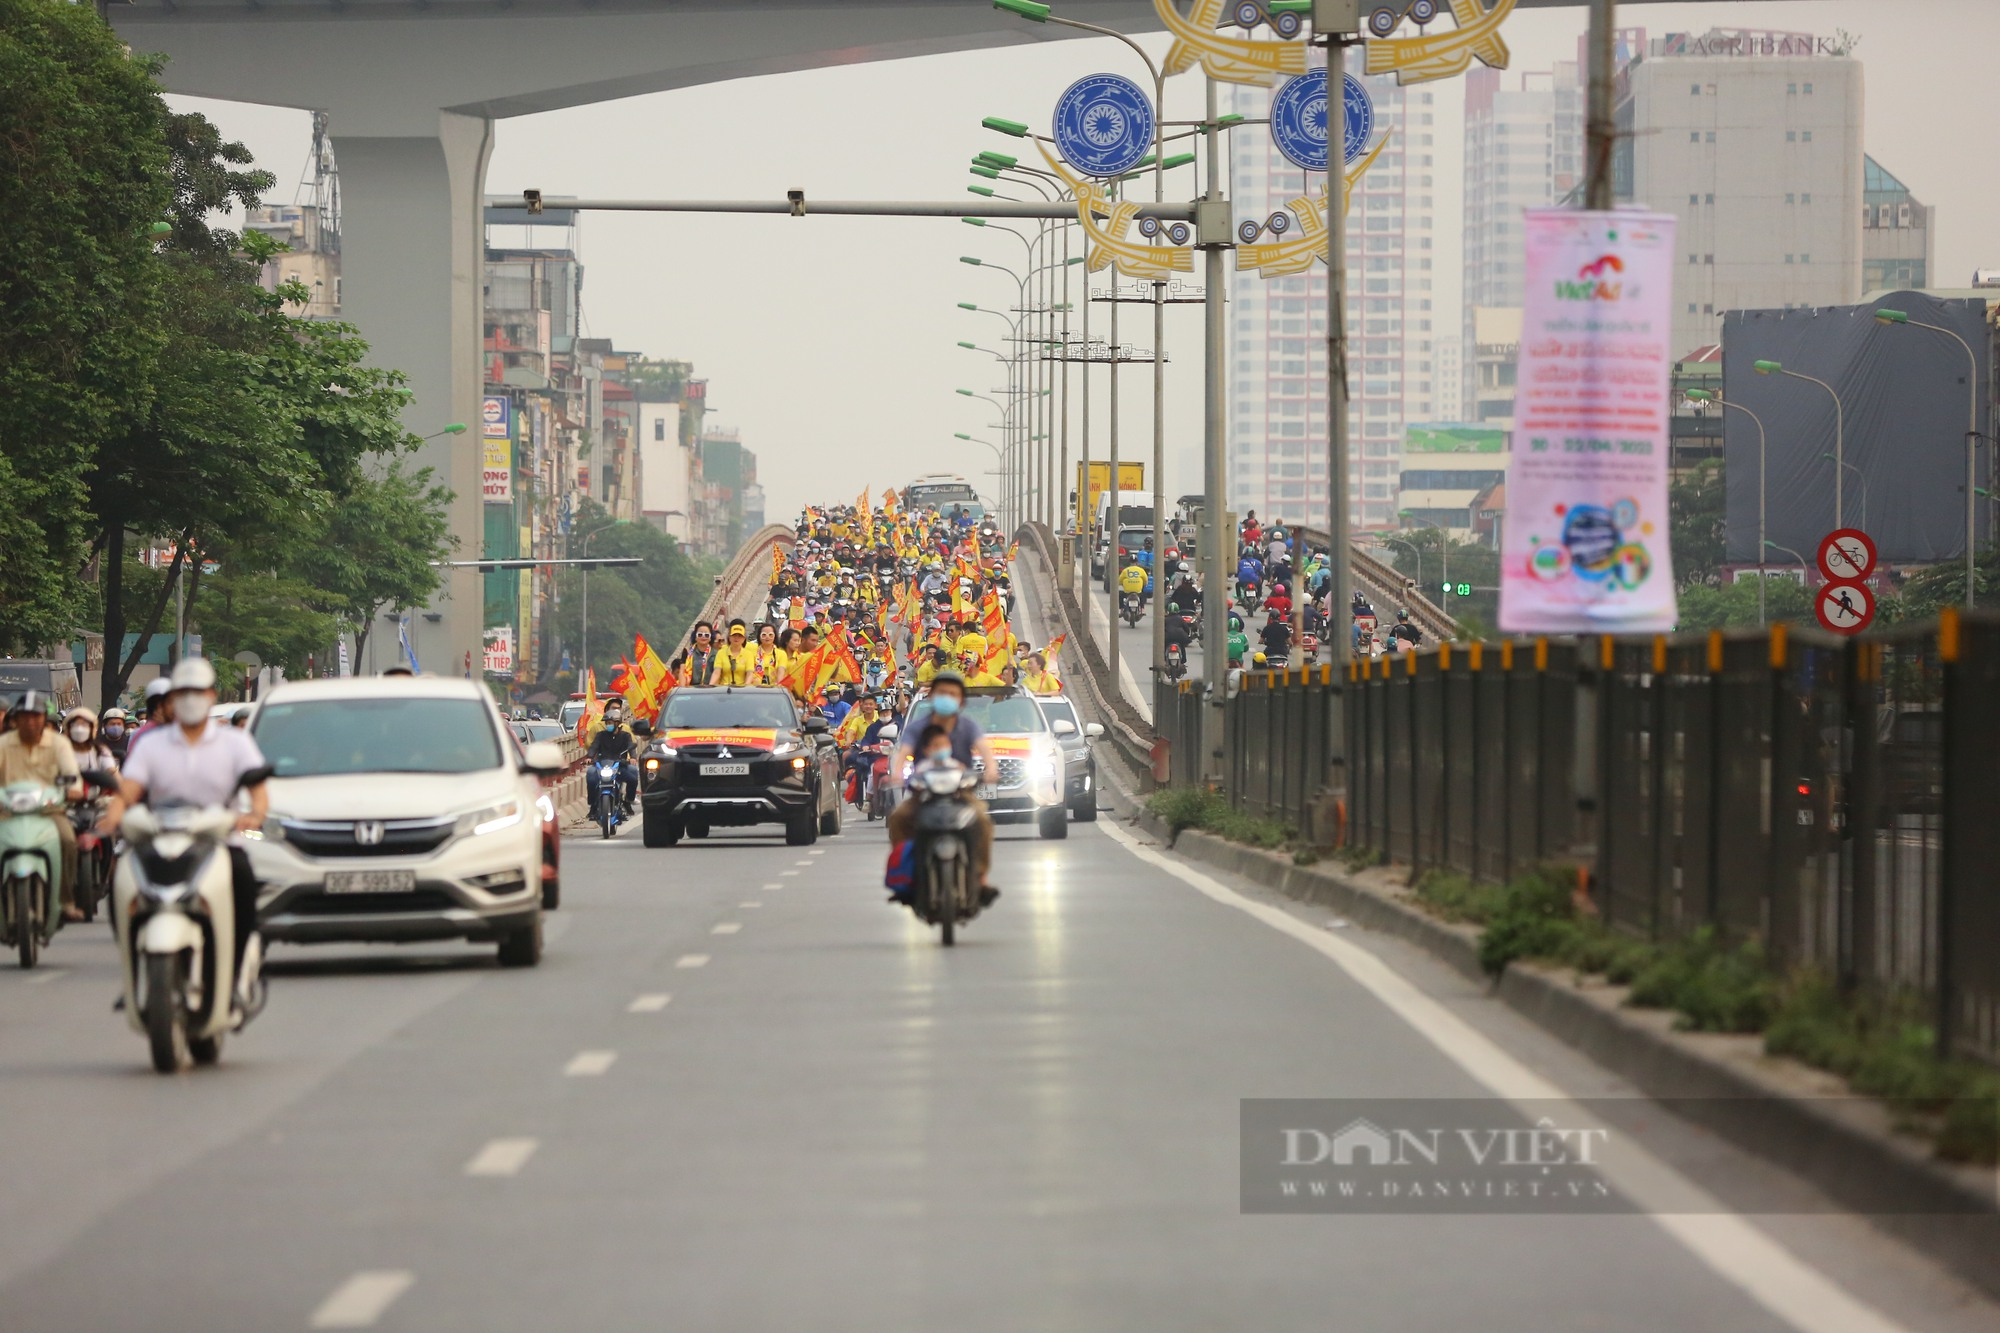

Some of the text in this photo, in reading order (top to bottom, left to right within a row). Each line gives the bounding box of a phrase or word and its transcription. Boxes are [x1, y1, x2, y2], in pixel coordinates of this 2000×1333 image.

[1692, 37, 1844, 57] AGRIBANK
[483, 471, 509, 483] ỌNG
[1457, 583, 1471, 596] 03
